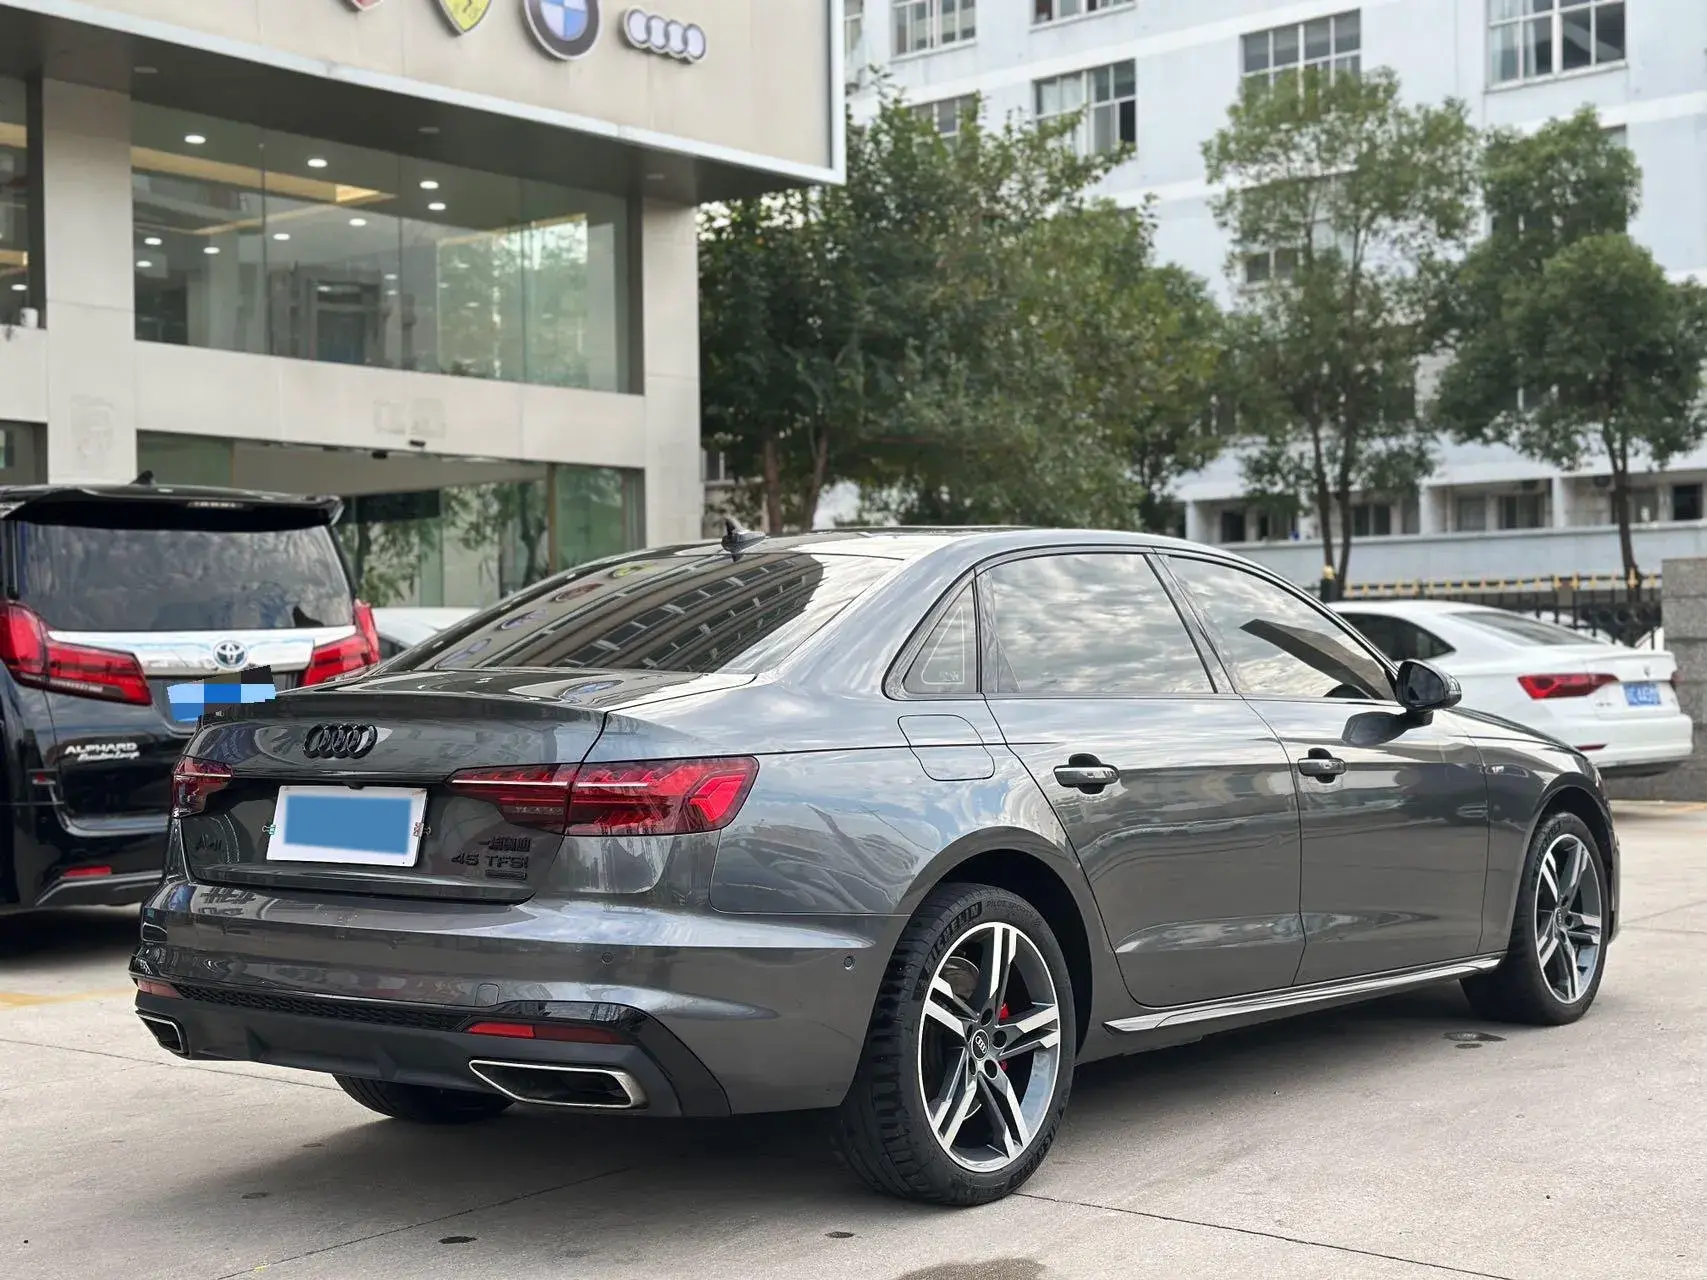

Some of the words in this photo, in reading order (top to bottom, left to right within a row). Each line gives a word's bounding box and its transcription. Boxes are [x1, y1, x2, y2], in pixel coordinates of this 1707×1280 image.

[64, 742, 138, 755] ALPHARD
[450, 853, 479, 865] 45
[485, 855, 529, 868] TFSI
[923, 902, 982, 974] MICHELIN
